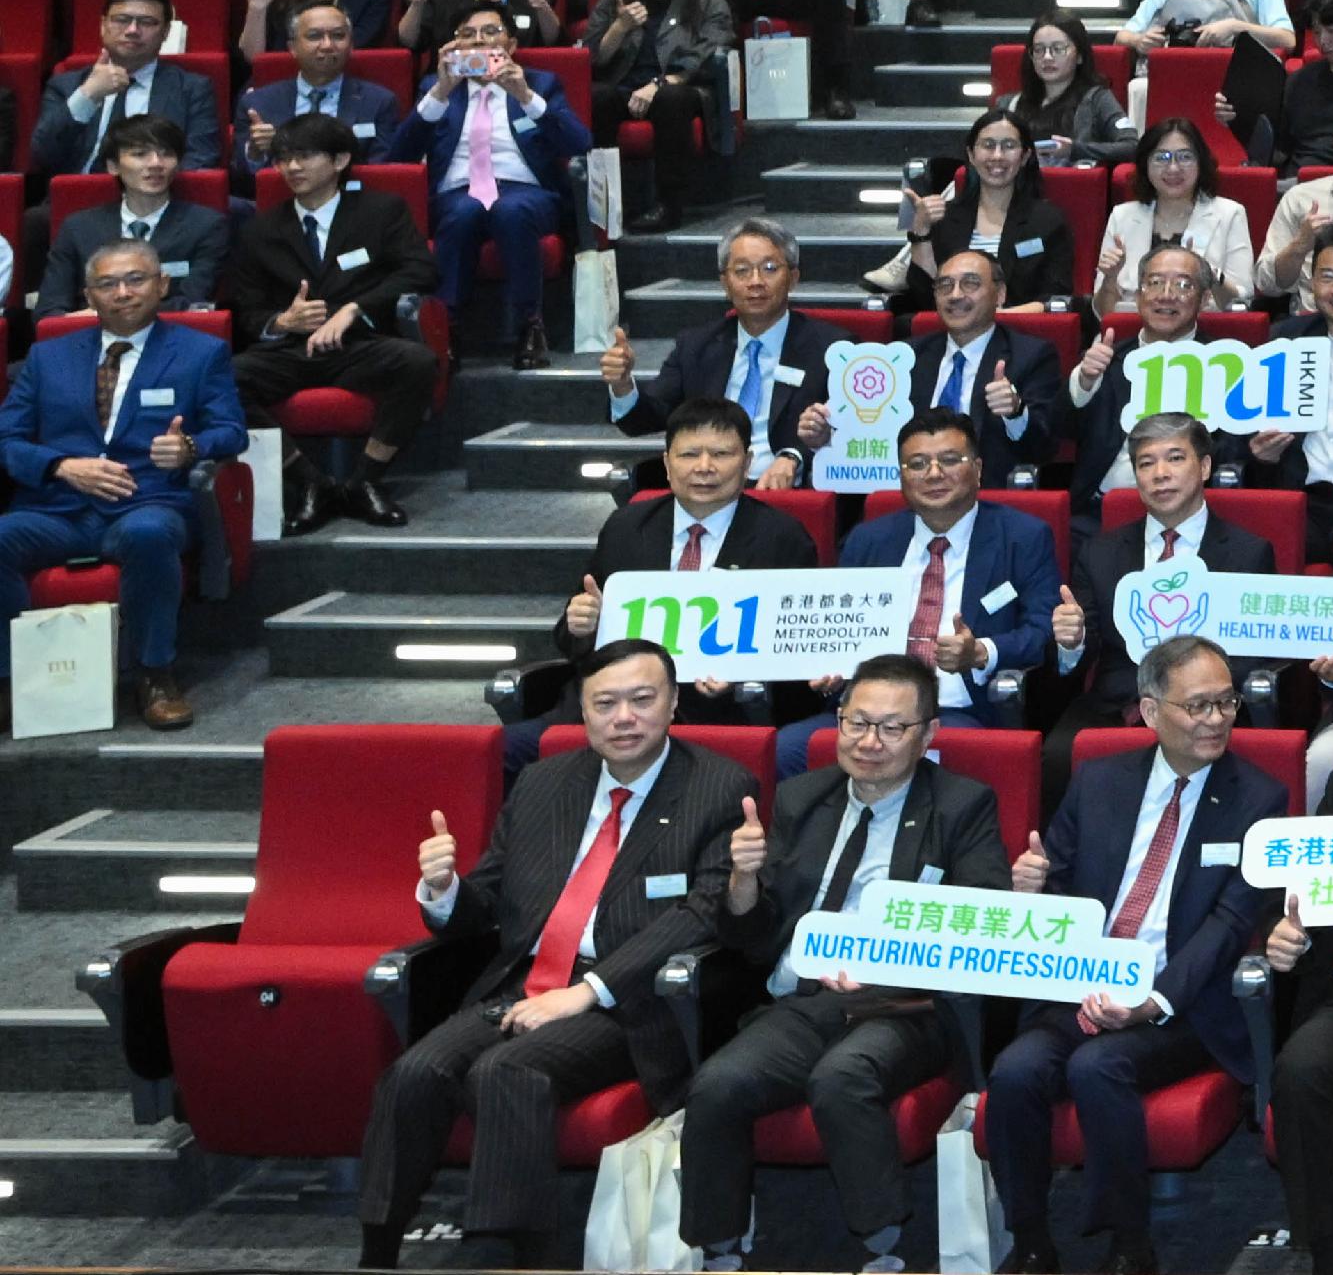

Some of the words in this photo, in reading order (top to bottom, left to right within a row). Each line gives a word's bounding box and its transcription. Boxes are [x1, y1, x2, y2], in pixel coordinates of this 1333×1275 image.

[1136, 352, 1290, 420] mu
[1297, 351, 1316, 417] HKMU
[846, 438, 890, 459] 創新
[826, 465, 900, 481] INNOVATIO
[780, 593, 893, 609] 香港都會大學
[776, 614, 819, 625] HONG
[824, 613, 865, 624] KONG
[774, 626, 890, 639] METROPOLITAN
[1219, 622, 1275, 639] HEALTH
[1280, 624, 1290, 640] &
[773, 641, 861, 653] UNIVERSITY
[882, 898, 1076, 945] 培育專業人才
[804, 933, 942, 968] NURTURING
[949, 946, 1141, 987] PROFESSIONALS
